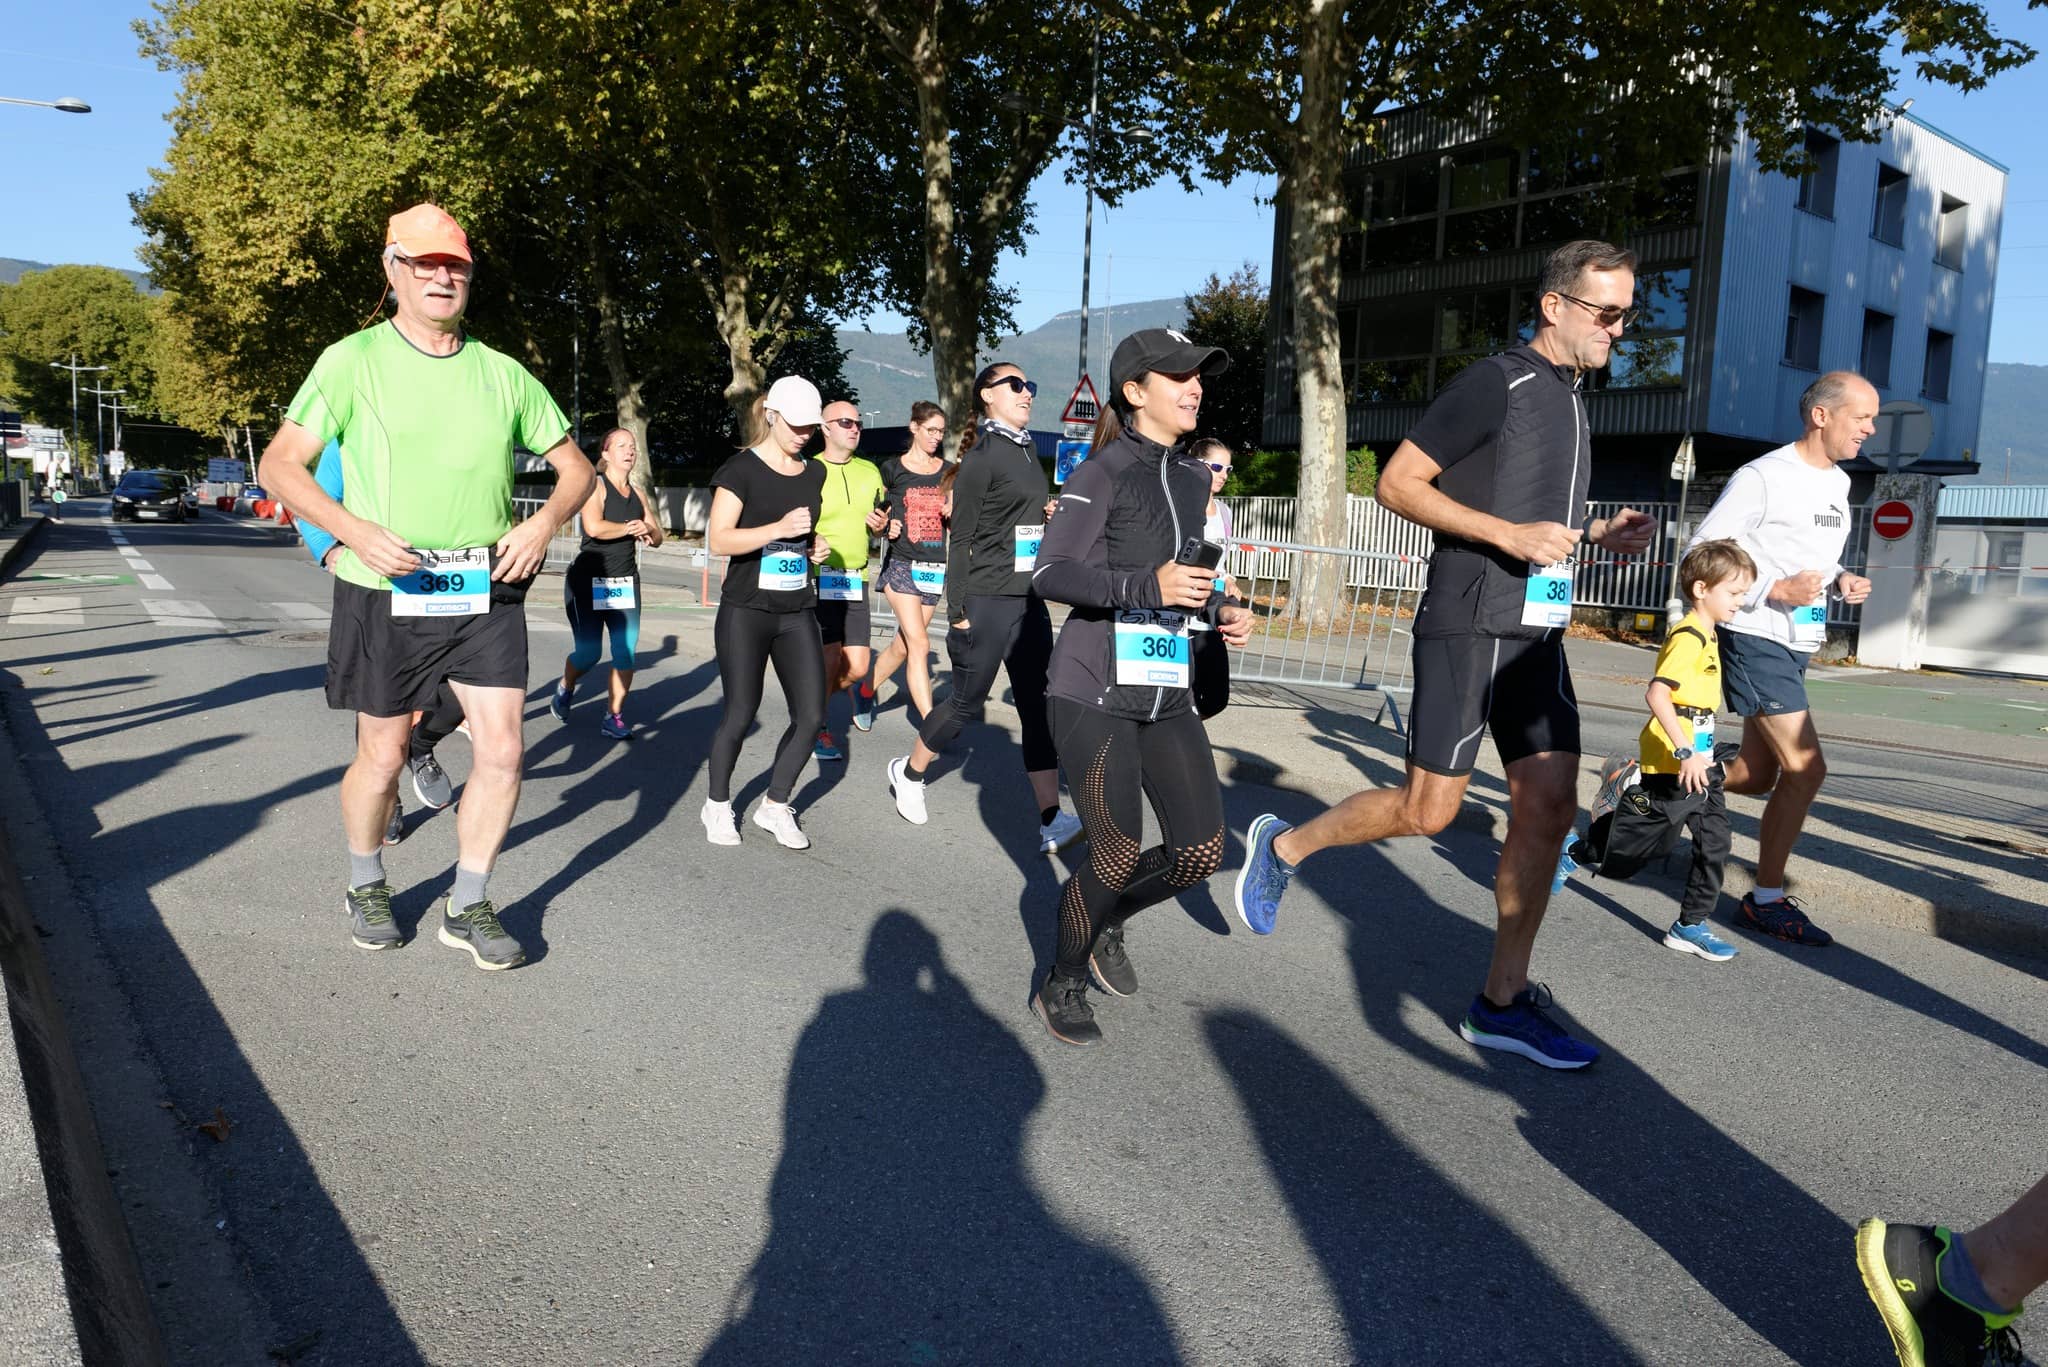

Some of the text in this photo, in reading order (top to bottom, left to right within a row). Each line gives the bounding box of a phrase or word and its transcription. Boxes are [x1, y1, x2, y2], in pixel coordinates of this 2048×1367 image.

[1814, 514, 1841, 529] PUMA
[778, 559, 803, 574] 353
[420, 573, 464, 593] 369
[919, 571, 936, 583] 352
[1547, 580, 1568, 602] 38
[1142, 636, 1177, 659] 360
